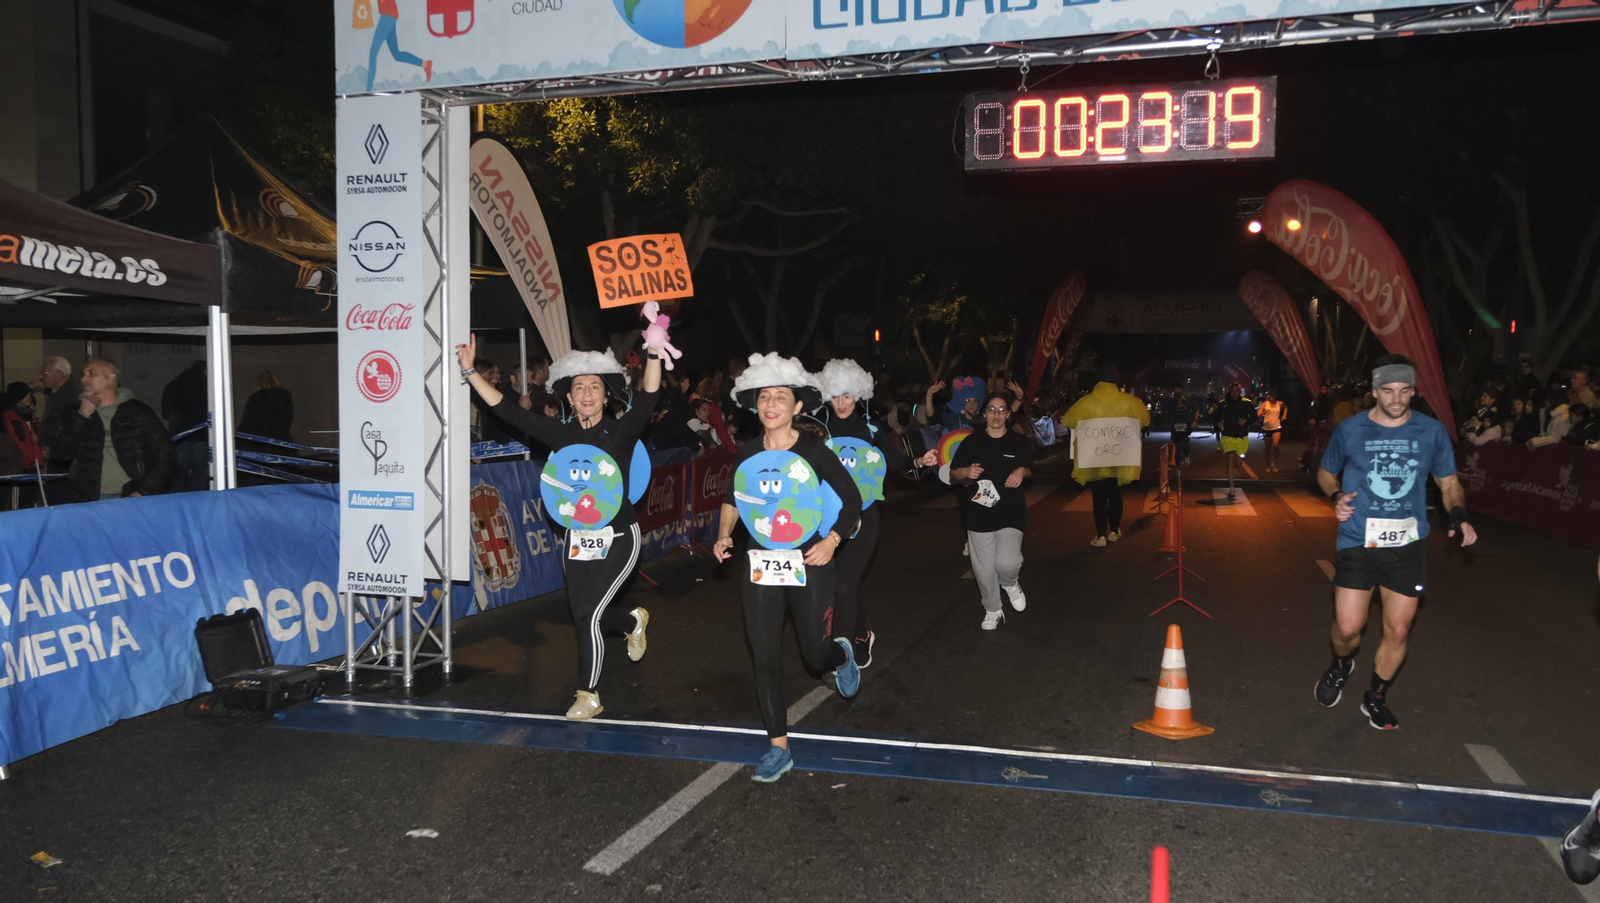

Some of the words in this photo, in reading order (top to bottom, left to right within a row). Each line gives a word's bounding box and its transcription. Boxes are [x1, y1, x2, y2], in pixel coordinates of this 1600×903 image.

[511, 0, 564, 15] CIUDAD
[346, 172, 408, 185] RENAULT
[346, 187, 366, 195] SYRSA
[366, 185, 407, 194] AUTOMOCION
[348, 242, 406, 252] NISSAN
[595, 239, 663, 275] SOS
[602, 268, 688, 301] SALINAS
[345, 303, 417, 331] Coca-Cola
[1085, 425, 1133, 440] COMPRO
[1095, 443, 1122, 456] ORO
[350, 493, 394, 507] Almericar
[525, 528, 552, 556] DE
[1378, 529, 1407, 542] 487
[580, 537, 604, 549] 828
[761, 559, 793, 571] 734
[347, 571, 408, 584] RENAULT
[347, 583, 366, 591] SYRSA
[366, 584, 407, 594] AUTOMOCION
